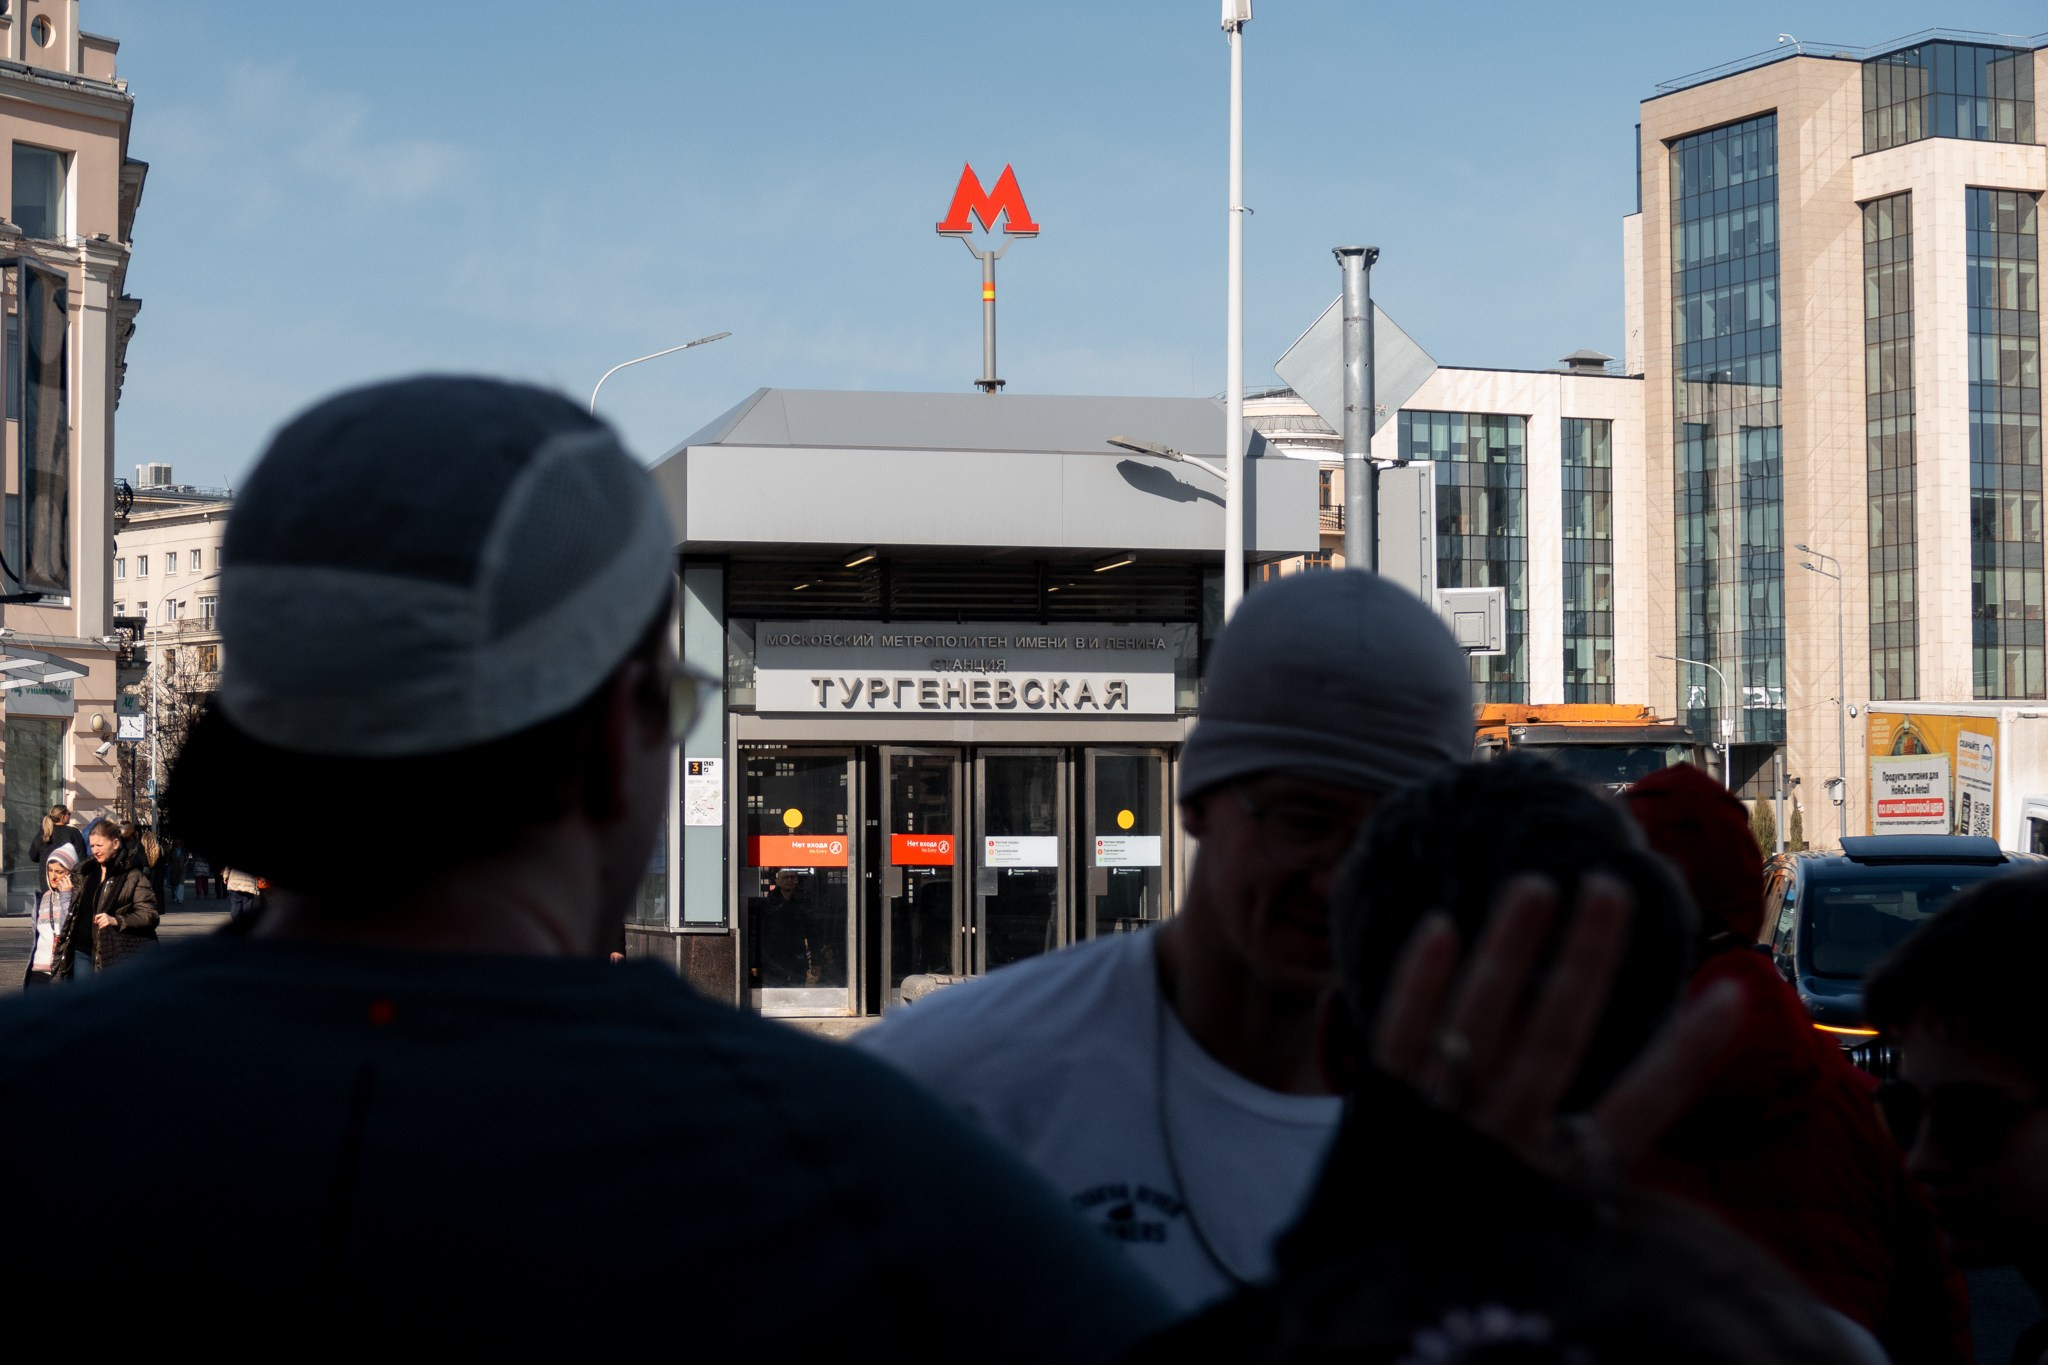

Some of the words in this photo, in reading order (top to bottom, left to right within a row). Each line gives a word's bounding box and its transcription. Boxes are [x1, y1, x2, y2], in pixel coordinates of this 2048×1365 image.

[936, 161, 1040, 234] М
[766, 633, 874, 647] МОСКОВСКИЙ
[882, 636, 1008, 648] МЕТРОПОЛИТЕН
[1015, 637, 1068, 649] ИМЕНИ
[1106, 638, 1166, 650] ЛЕНИНА
[931, 658, 1007, 675] СТАНЦИЯ
[811, 677, 1128, 710] ТУРГЕНЕВСКАЯ
[692, 762, 699, 772] 3
